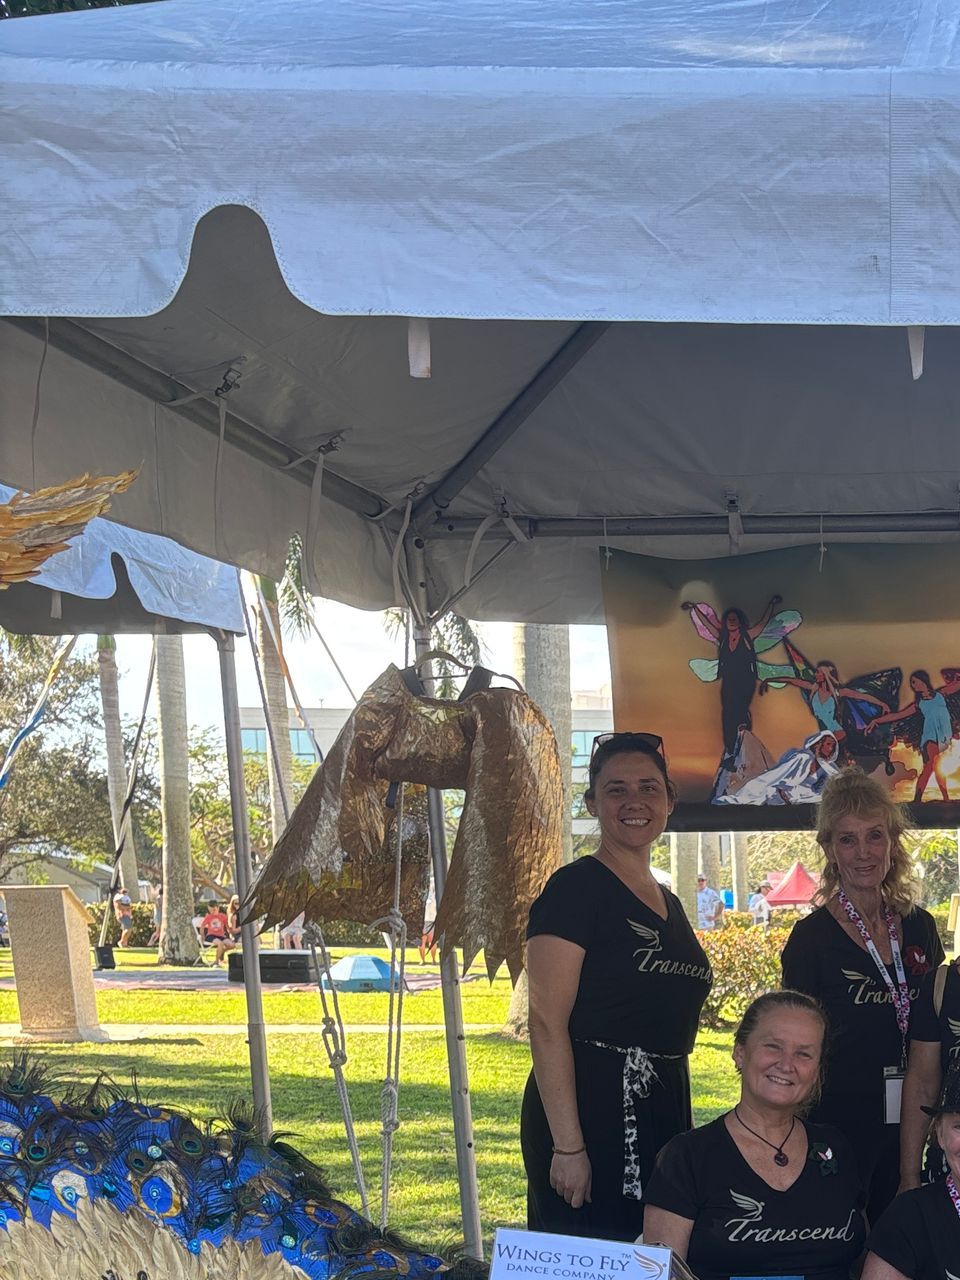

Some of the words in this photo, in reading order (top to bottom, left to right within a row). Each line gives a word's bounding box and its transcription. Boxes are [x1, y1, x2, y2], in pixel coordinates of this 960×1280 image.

[724, 1208, 856, 1243] Transcend
[497, 1243, 562, 1264] WINGS
[566, 1253, 594, 1268] TO
[600, 1255, 631, 1272] FLY
[506, 1263, 549, 1276] DANCE
